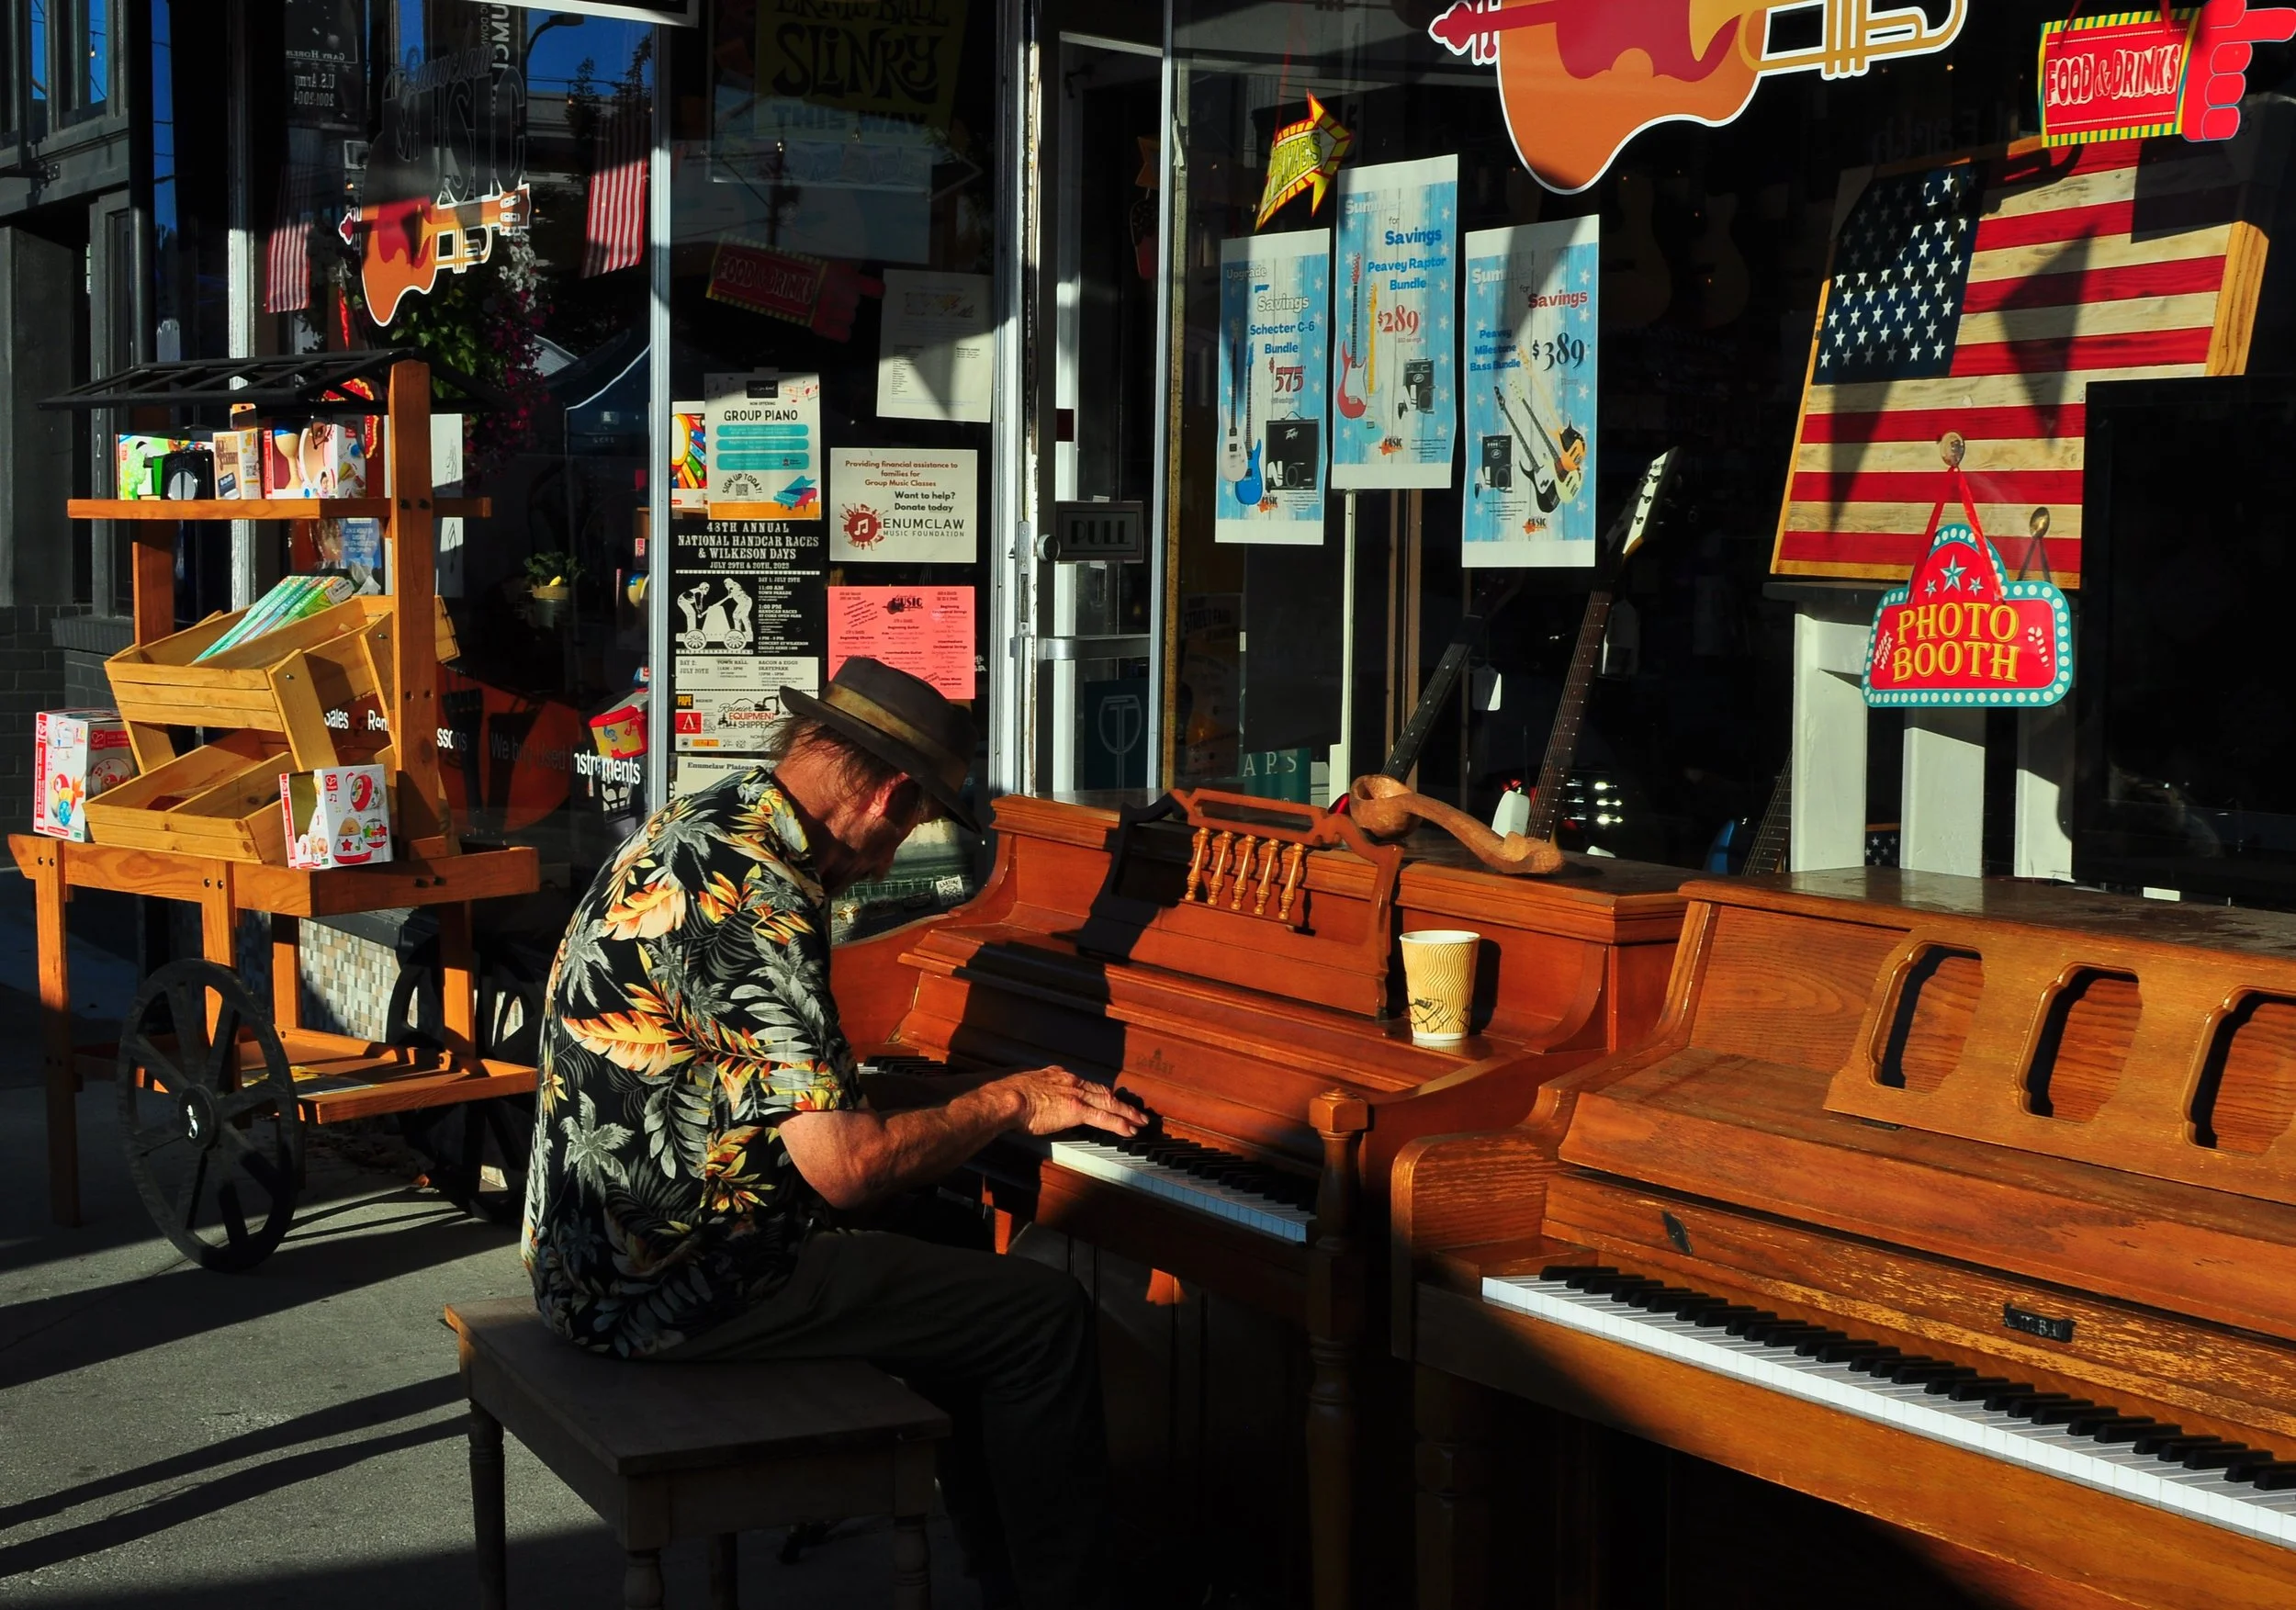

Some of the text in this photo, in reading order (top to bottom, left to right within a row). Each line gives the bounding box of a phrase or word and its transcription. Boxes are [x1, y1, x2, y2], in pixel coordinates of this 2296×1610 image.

[2045, 44, 2183, 107] FOOD & DRINKS
[381, 65, 526, 204] MUSIC
[1389, 216, 1401, 225] for
[1385, 227, 1443, 246] Savings
[1367, 256, 1447, 274] Peavey Raptor
[1226, 265, 1267, 280] Upgrade
[1390, 277, 1427, 291] Bundle
[1256, 292, 1310, 314] Savings
[1528, 289, 1588, 310] Savings
[1378, 304, 1420, 336] $289
[1249, 320, 1315, 336] Schecter C-6
[1480, 329, 1513, 339] Peavey
[1265, 343, 1299, 355] Bundle
[1474, 343, 1517, 356] Milestone
[1532, 332, 1585, 372] $389
[1469, 358, 1521, 372] Bass Bundle
[1268, 357, 1304, 393] $575
[724, 410, 798, 422] GROUP PIANO
[845, 460, 880, 469] Providing
[882, 460, 912, 468] financial
[881, 469, 920, 478] families for
[722, 472, 763, 494] SIGN UP TODAY!
[895, 490, 955, 501] Want to help?
[928, 503, 954, 512] today
[742, 522, 790, 533] ANNUAL
[883, 518, 964, 529] ENUMCLAW
[1071, 520, 1131, 545] PULL
[678, 535, 819, 547] NATIONAL HANDCAR RACES
[698, 547, 797, 560] & WILKESON DAYS
[1896, 602, 2020, 646] PHOTO
[1892, 640, 2020, 682] BOOTH
[718, 703, 753, 714] Rainier
[738, 720, 775, 729] SHIPPERS
[490, 732, 510, 760] We
[569, 749, 642, 785] Instruments
